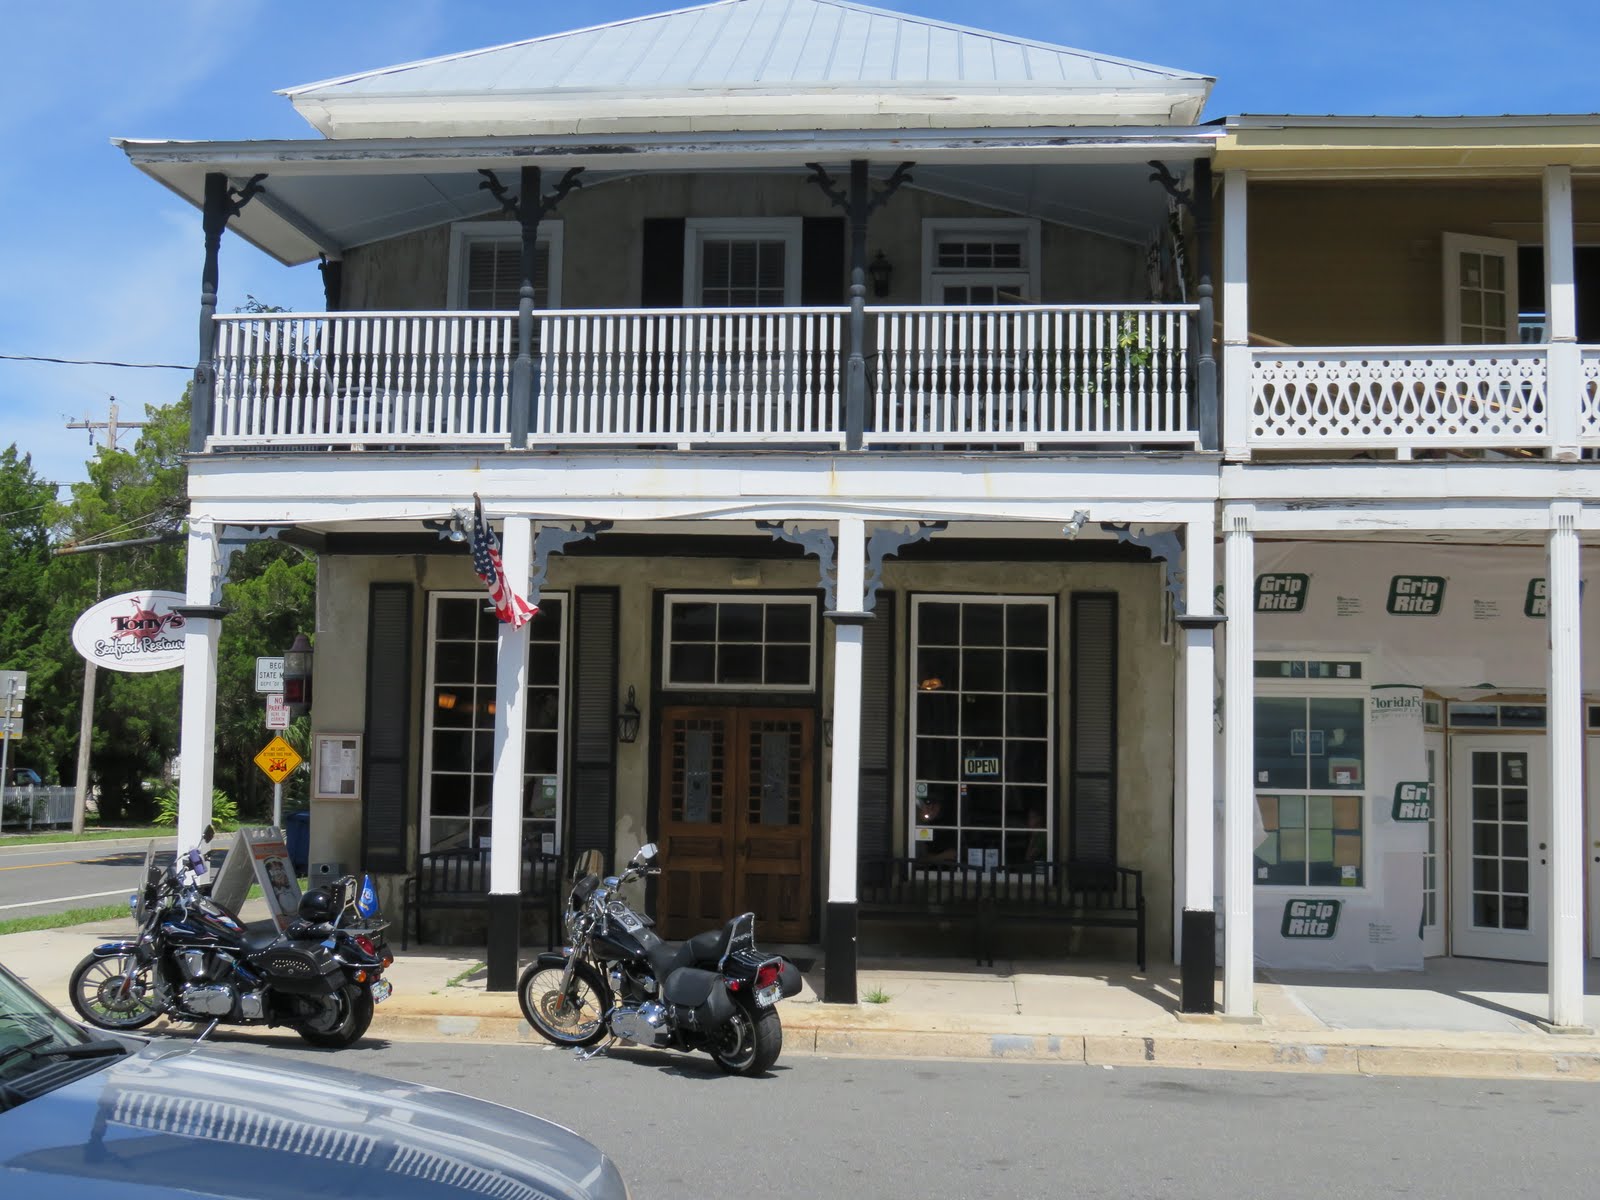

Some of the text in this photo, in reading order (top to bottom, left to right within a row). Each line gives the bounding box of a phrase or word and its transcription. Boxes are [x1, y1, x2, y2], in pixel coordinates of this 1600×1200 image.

[1259, 576, 1302, 594] Grip
[1396, 578, 1438, 597] Grip
[1258, 593, 1298, 610] Rite
[1394, 596, 1434, 612] Rite
[111, 613, 186, 637] Tony's
[95, 638, 139, 660] Seafood
[259, 671, 277, 679] STATE
[967, 759, 996, 773] OPEN
[1400, 784, 1430, 801] Gri
[1399, 802, 1430, 819] Rit
[1290, 901, 1334, 920] Grip
[1288, 918, 1329, 935] Rite
